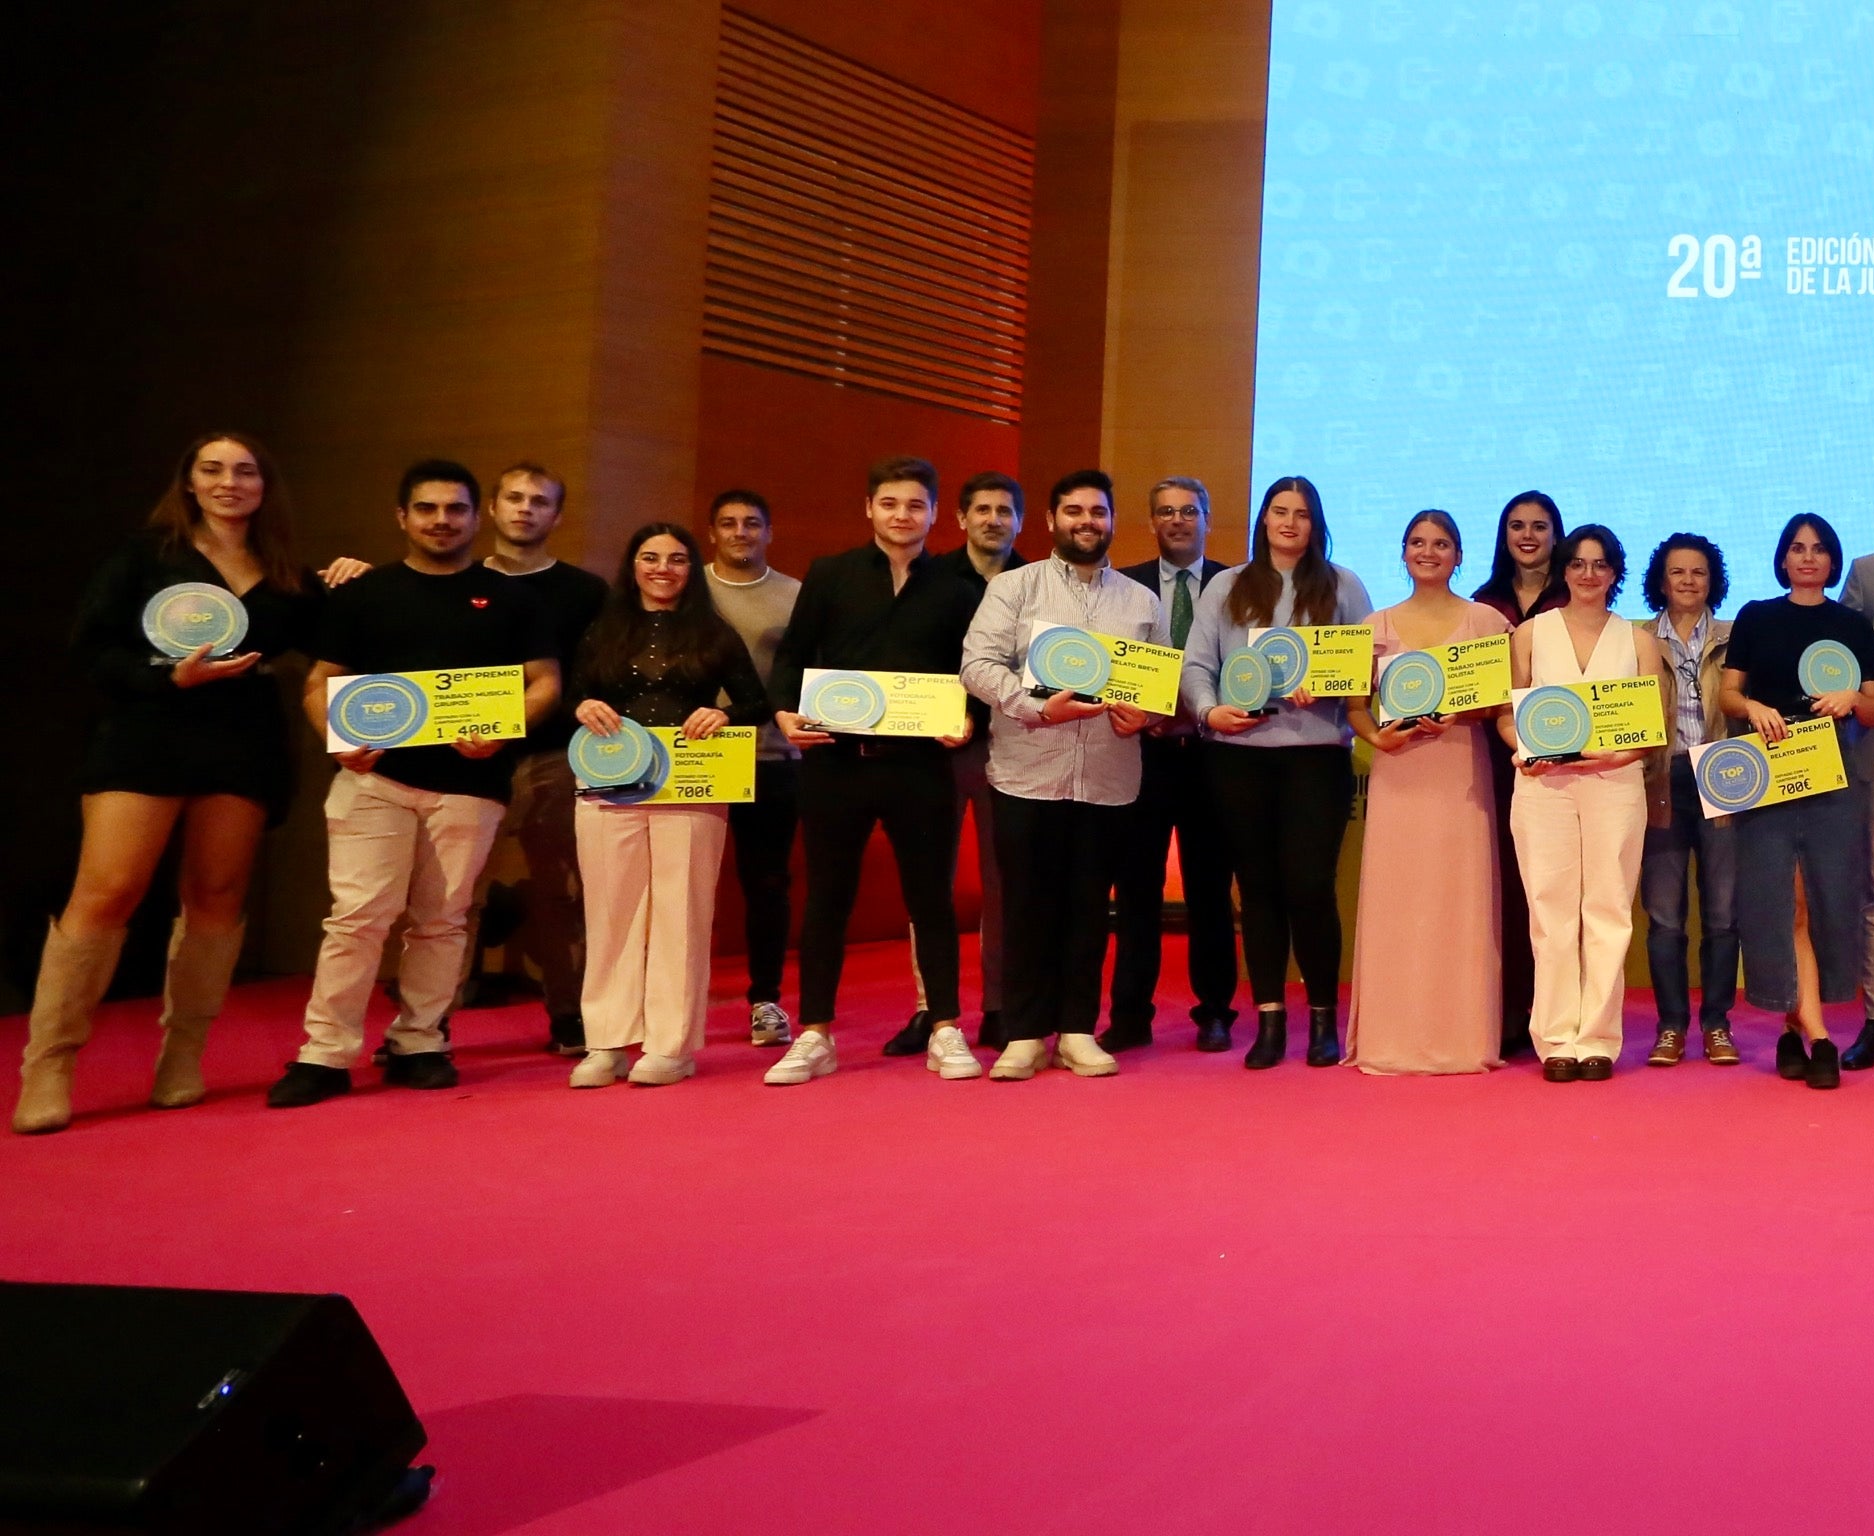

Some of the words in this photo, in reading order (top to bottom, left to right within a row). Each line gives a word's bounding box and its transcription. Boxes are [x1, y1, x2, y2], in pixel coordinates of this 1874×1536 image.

[1786, 268, 1816, 295] DE
[1823, 268, 1852, 296] LA
[1340, 629, 1371, 637] PREMIO
[1474, 638, 1506, 650] PREMIO
[1145, 647, 1180, 660] PREMIO
[1062, 655, 1086, 667] TOP
[1267, 654, 1288, 665] TOP
[1137, 664, 1159, 673] BREVE
[1447, 663, 1475, 672] TRABAJO
[1821, 664, 1842, 676] TOP
[475, 670, 519, 679] PREMIO
[1236, 672, 1253, 682] TOP
[1447, 669, 1475, 679] SOLISTAS
[1401, 679, 1422, 690] TOP
[1621, 679, 1655, 689] PREMIO
[434, 692, 473, 700] TRABAJO
[832, 695, 860, 705] TOP
[1105, 688, 1141, 704] 300€
[1449, 692, 1479, 708] 400€
[361, 702, 396, 715] TOP
[434, 700, 470, 708] GRUPOS
[887, 721, 924, 731] 300€
[1542, 716, 1566, 727] TOP
[1797, 721, 1831, 735] PREMIO
[712, 731, 752, 739] PREMIO
[596, 744, 625, 754] TOP
[1770, 750, 1795, 759] RELATO
[1796, 745, 1818, 754] BREVE
[1719, 766, 1744, 779] TOP
[675, 785, 714, 798] 700€
[1778, 779, 1812, 796] 700€
